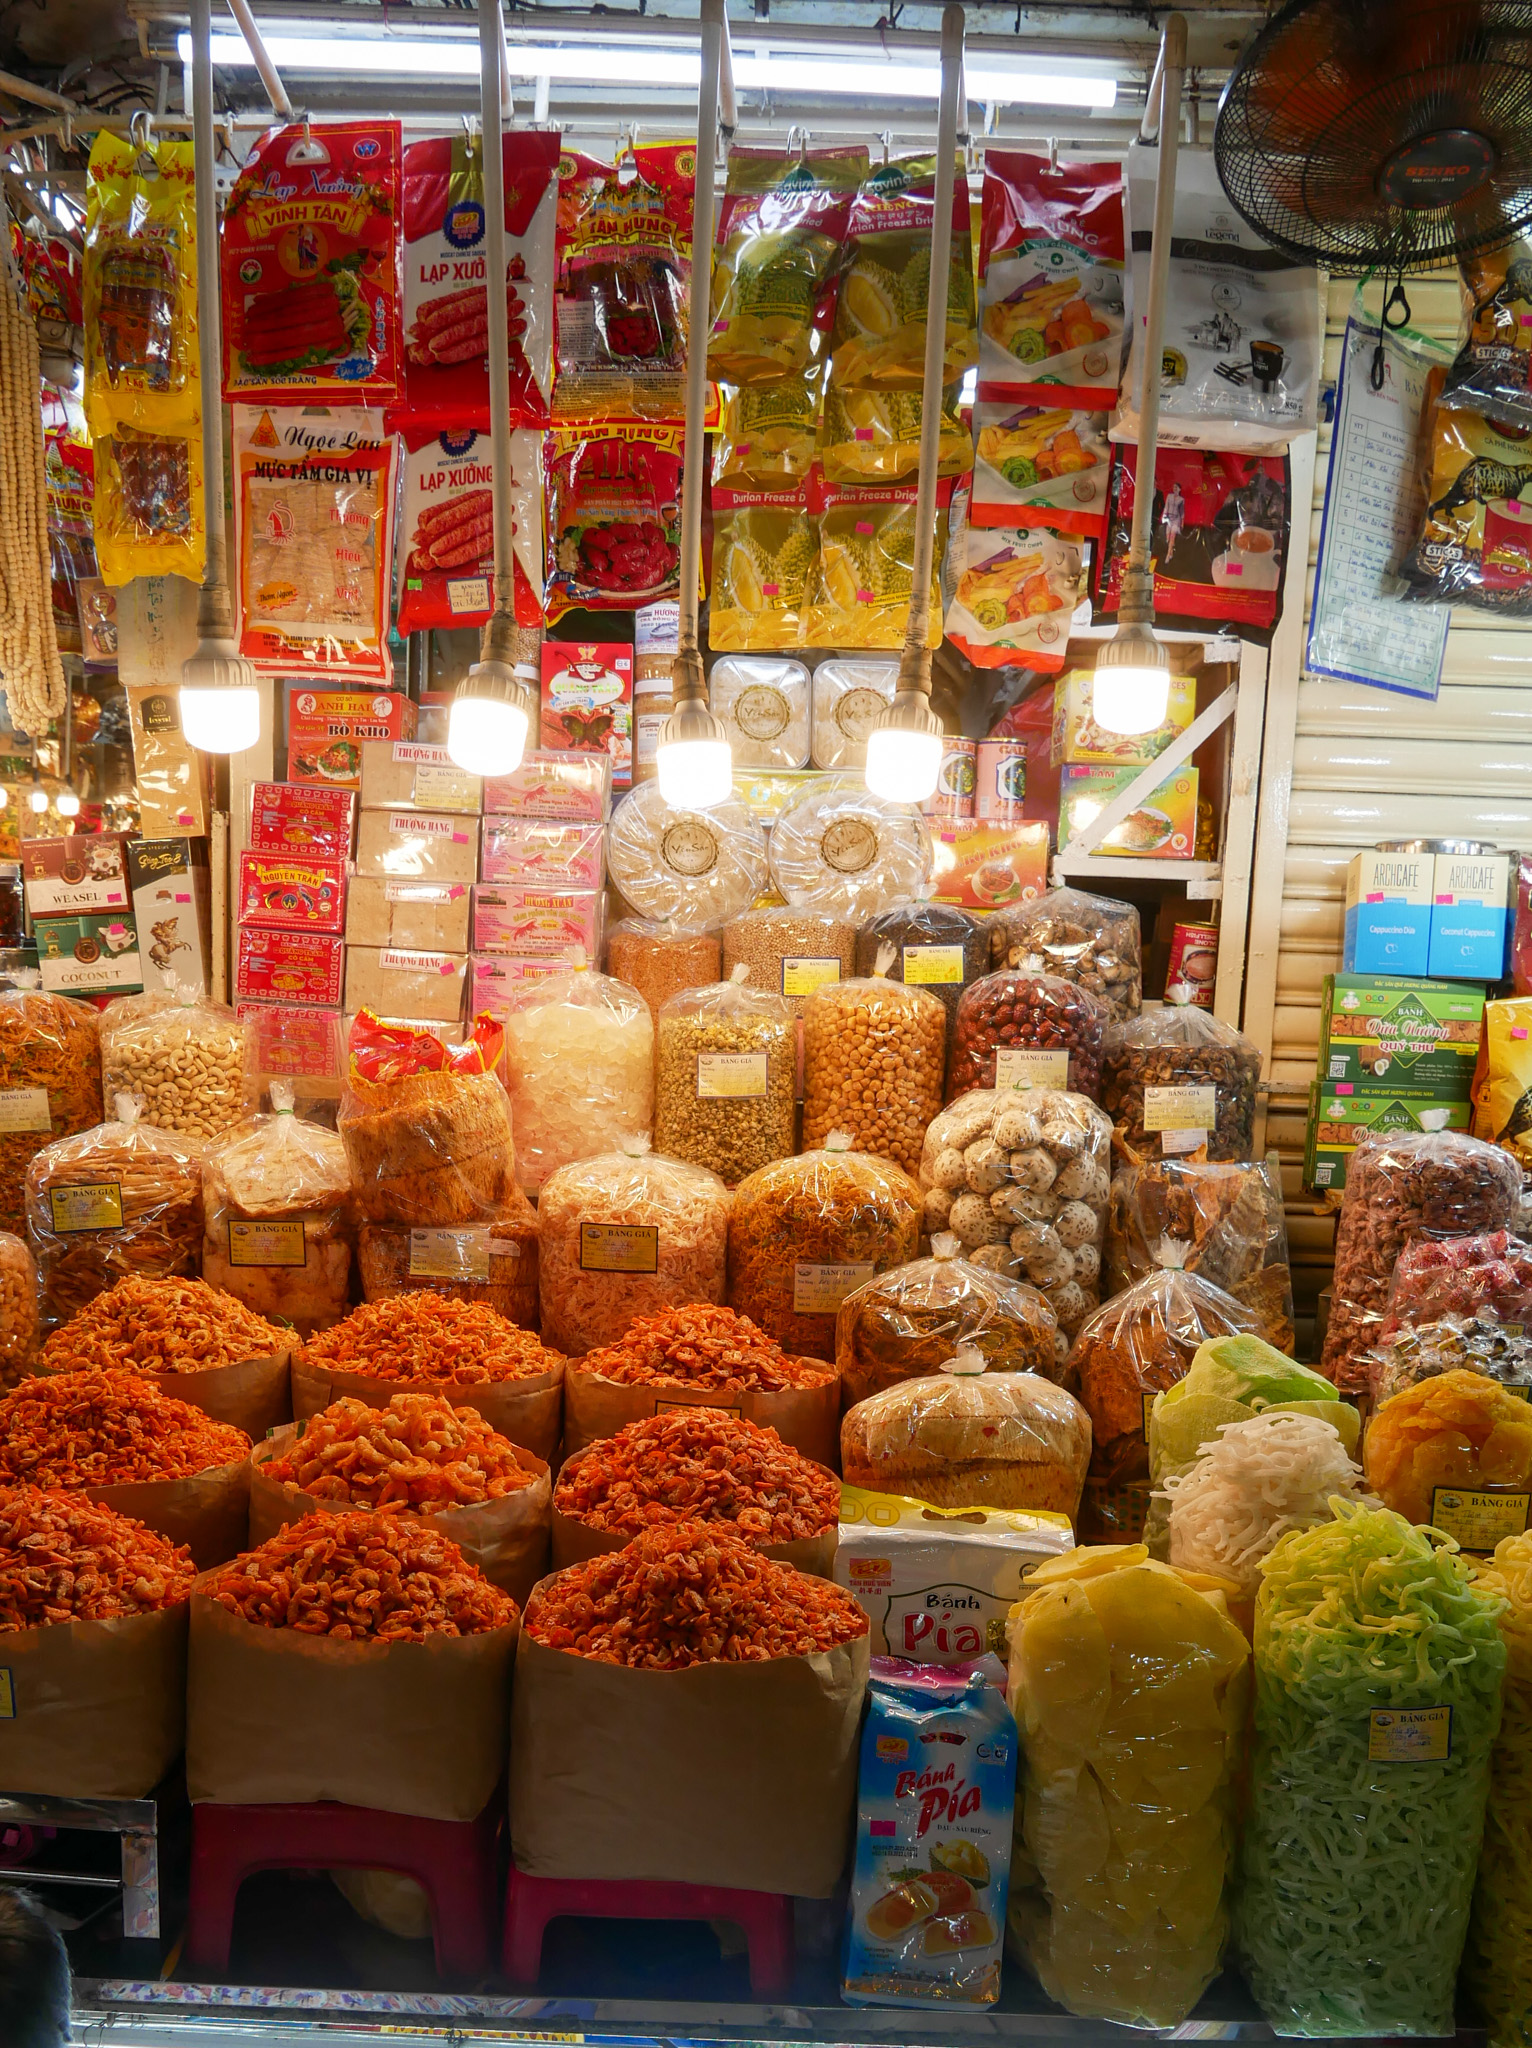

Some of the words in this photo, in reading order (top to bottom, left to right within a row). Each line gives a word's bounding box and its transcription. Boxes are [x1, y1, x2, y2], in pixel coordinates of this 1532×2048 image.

[1405, 165, 1470, 177] SENKO
[252, 171, 297, 202] Lạp
[302, 168, 366, 198] Xưởng
[313, 203, 348, 224] TÂN
[588, 217, 618, 234] TÂN
[623, 217, 672, 234] HƯNG
[878, 219, 912, 231] Freeze
[1205, 229, 1239, 243] Legend
[420, 263, 449, 285] LẠP
[1045, 266, 1060, 274] FRUIT
[1061, 265, 1080, 274] CHIPS
[1285, 401, 1297, 410] 850
[284, 425, 337, 454] Ngọc
[339, 430, 380, 451] Lan
[1484, 435, 1494, 446] CÀ
[1495, 437, 1506, 449] PHÊ
[254, 459, 287, 483] MỰC
[324, 466, 351, 484] GIA
[355, 468, 372, 490] VỊ
[420, 472, 445, 493] LẠP
[447, 462, 493, 487] XƯỞNG
[733, 492, 761, 504] Durian
[764, 491, 795, 503] Freeze
[859, 489, 891, 502] Freeze
[1001, 536, 1012, 545] MIX
[1028, 540, 1043, 549] CHIPS
[316, 702, 345, 712] ANH
[348, 703, 371, 712] HAI
[327, 720, 351, 738] BÒ
[353, 725, 391, 738] KHO
[397, 745, 430, 761] THƯỢNG
[437, 770, 455, 778] BẢNG
[394, 816, 426, 832] THƯỢNG
[428, 820, 450, 834] HẠNG
[173, 853, 182, 863] 8
[1373, 861, 1419, 887] ARCHCAFÉ
[1449, 864, 1495, 890] ARCHCAFÉ
[52, 891, 101, 905] WEASEL
[524, 894, 550, 908] HƯƠNG
[551, 896, 573, 907] XUÂN
[1369, 925, 1403, 935] Cappuccino
[1440, 927, 1464, 936] Coconut
[1464, 928, 1496, 938] Cappuccino
[384, 954, 417, 967] THƯỢNG
[418, 957, 440, 969] HẠNG
[61, 969, 121, 984] COCONUT
[1367, 1018, 1398, 1037] Dừa
[1402, 1018, 1451, 1042] Nướng
[1379, 1040, 1407, 1053] QUÝ
[1409, 1042, 1435, 1053] THU
[721, 1056, 740, 1064] BẢNG
[1020, 1053, 1040, 1062] BẢNG
[1041, 1053, 1053, 1062] GIÁ
[20, 1091, 32, 1100] GIÁ
[1167, 1088, 1186, 1098] BẢNG
[1187, 1088, 1200, 1097] GIÁ
[73, 1188, 96, 1198] BẢNG
[98, 1187, 115, 1196] GIÁ
[255, 1225, 279, 1233] BẢNG
[281, 1224, 298, 1233] GIÁ
[608, 1228, 632, 1238] BẢNG
[635, 1229, 651, 1239] GIÁ
[820, 1268, 841, 1276] BẢNG
[1471, 1496, 1503, 1508] BẢNG
[1505, 1498, 1523, 1508] GIÁ
[849, 1578, 862, 1587] TÂN
[863, 1578, 876, 1587] HUÊ
[877, 1579, 892, 1587] VIÊN
[925, 1593, 981, 1611] Bánh
[903, 1611, 982, 1653] Pía
[1400, 1712, 1426, 1723] BẢNG
[1428, 1711, 1444, 1721] GIÁ
[895, 1762, 955, 1799] Bánh
[916, 1778, 981, 1839] Pía
[970, 1825, 991, 1835] RIÊNG
